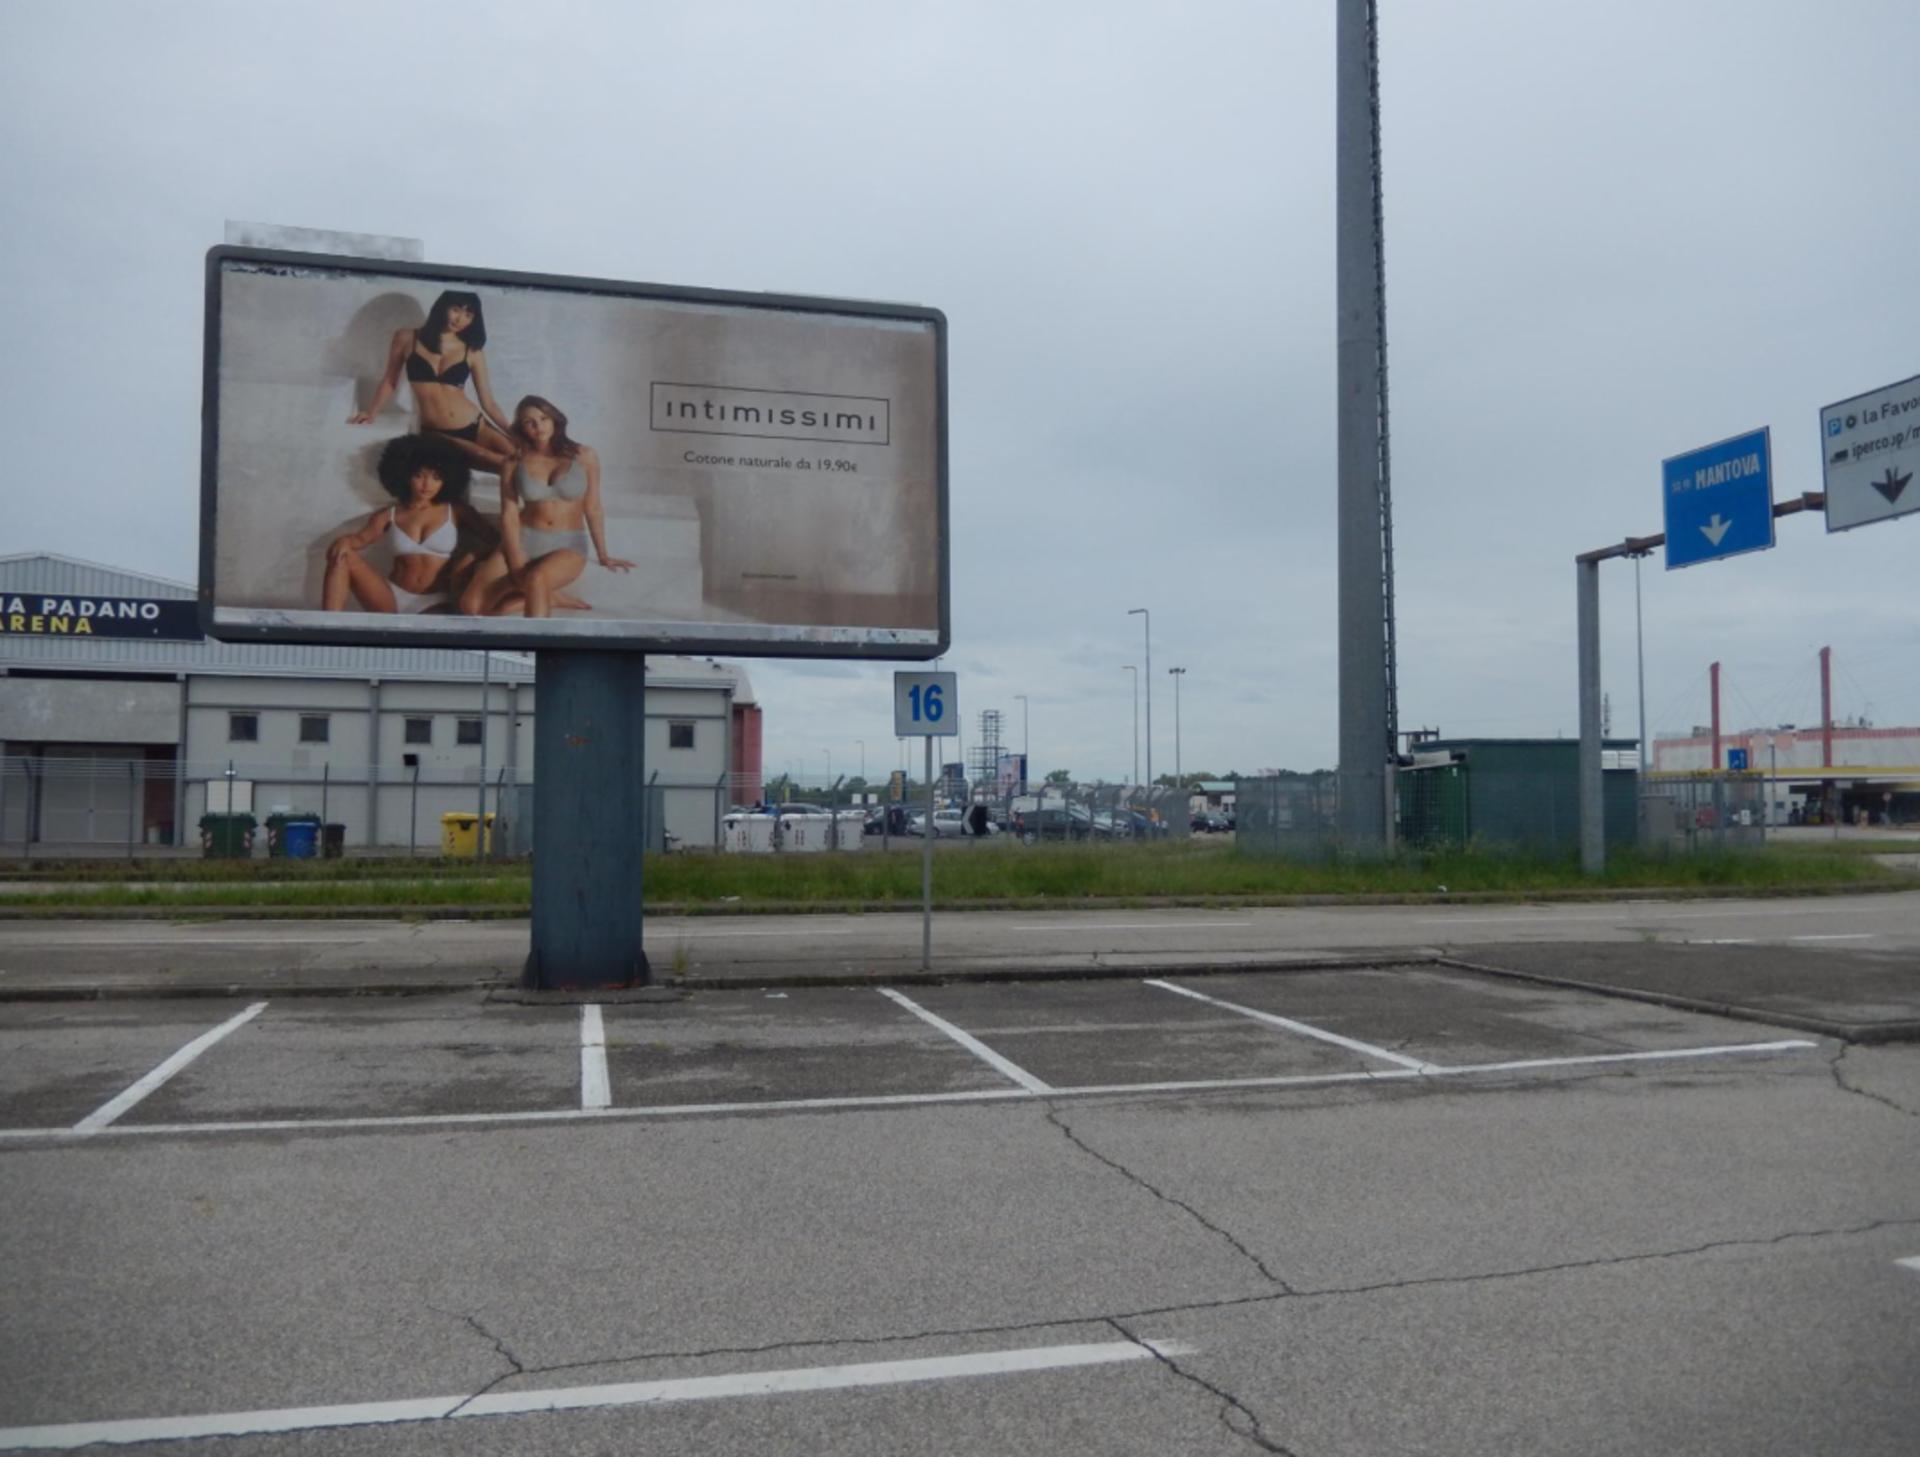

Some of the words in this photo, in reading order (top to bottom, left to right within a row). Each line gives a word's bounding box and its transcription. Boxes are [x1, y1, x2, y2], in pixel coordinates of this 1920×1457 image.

[666, 400, 876, 431] intimissimi
[1863, 409, 1878, 424] la
[1881, 396, 1920, 419] Favo
[683, 451, 735, 466] Cotone
[739, 456, 792, 469] naturale
[796, 457, 811, 470] da
[1695, 453, 1760, 490] MANTOVA
[0, 597, 26, 614] A
[42, 599, 160, 619] PADANO
[908, 684, 943, 722] 16
